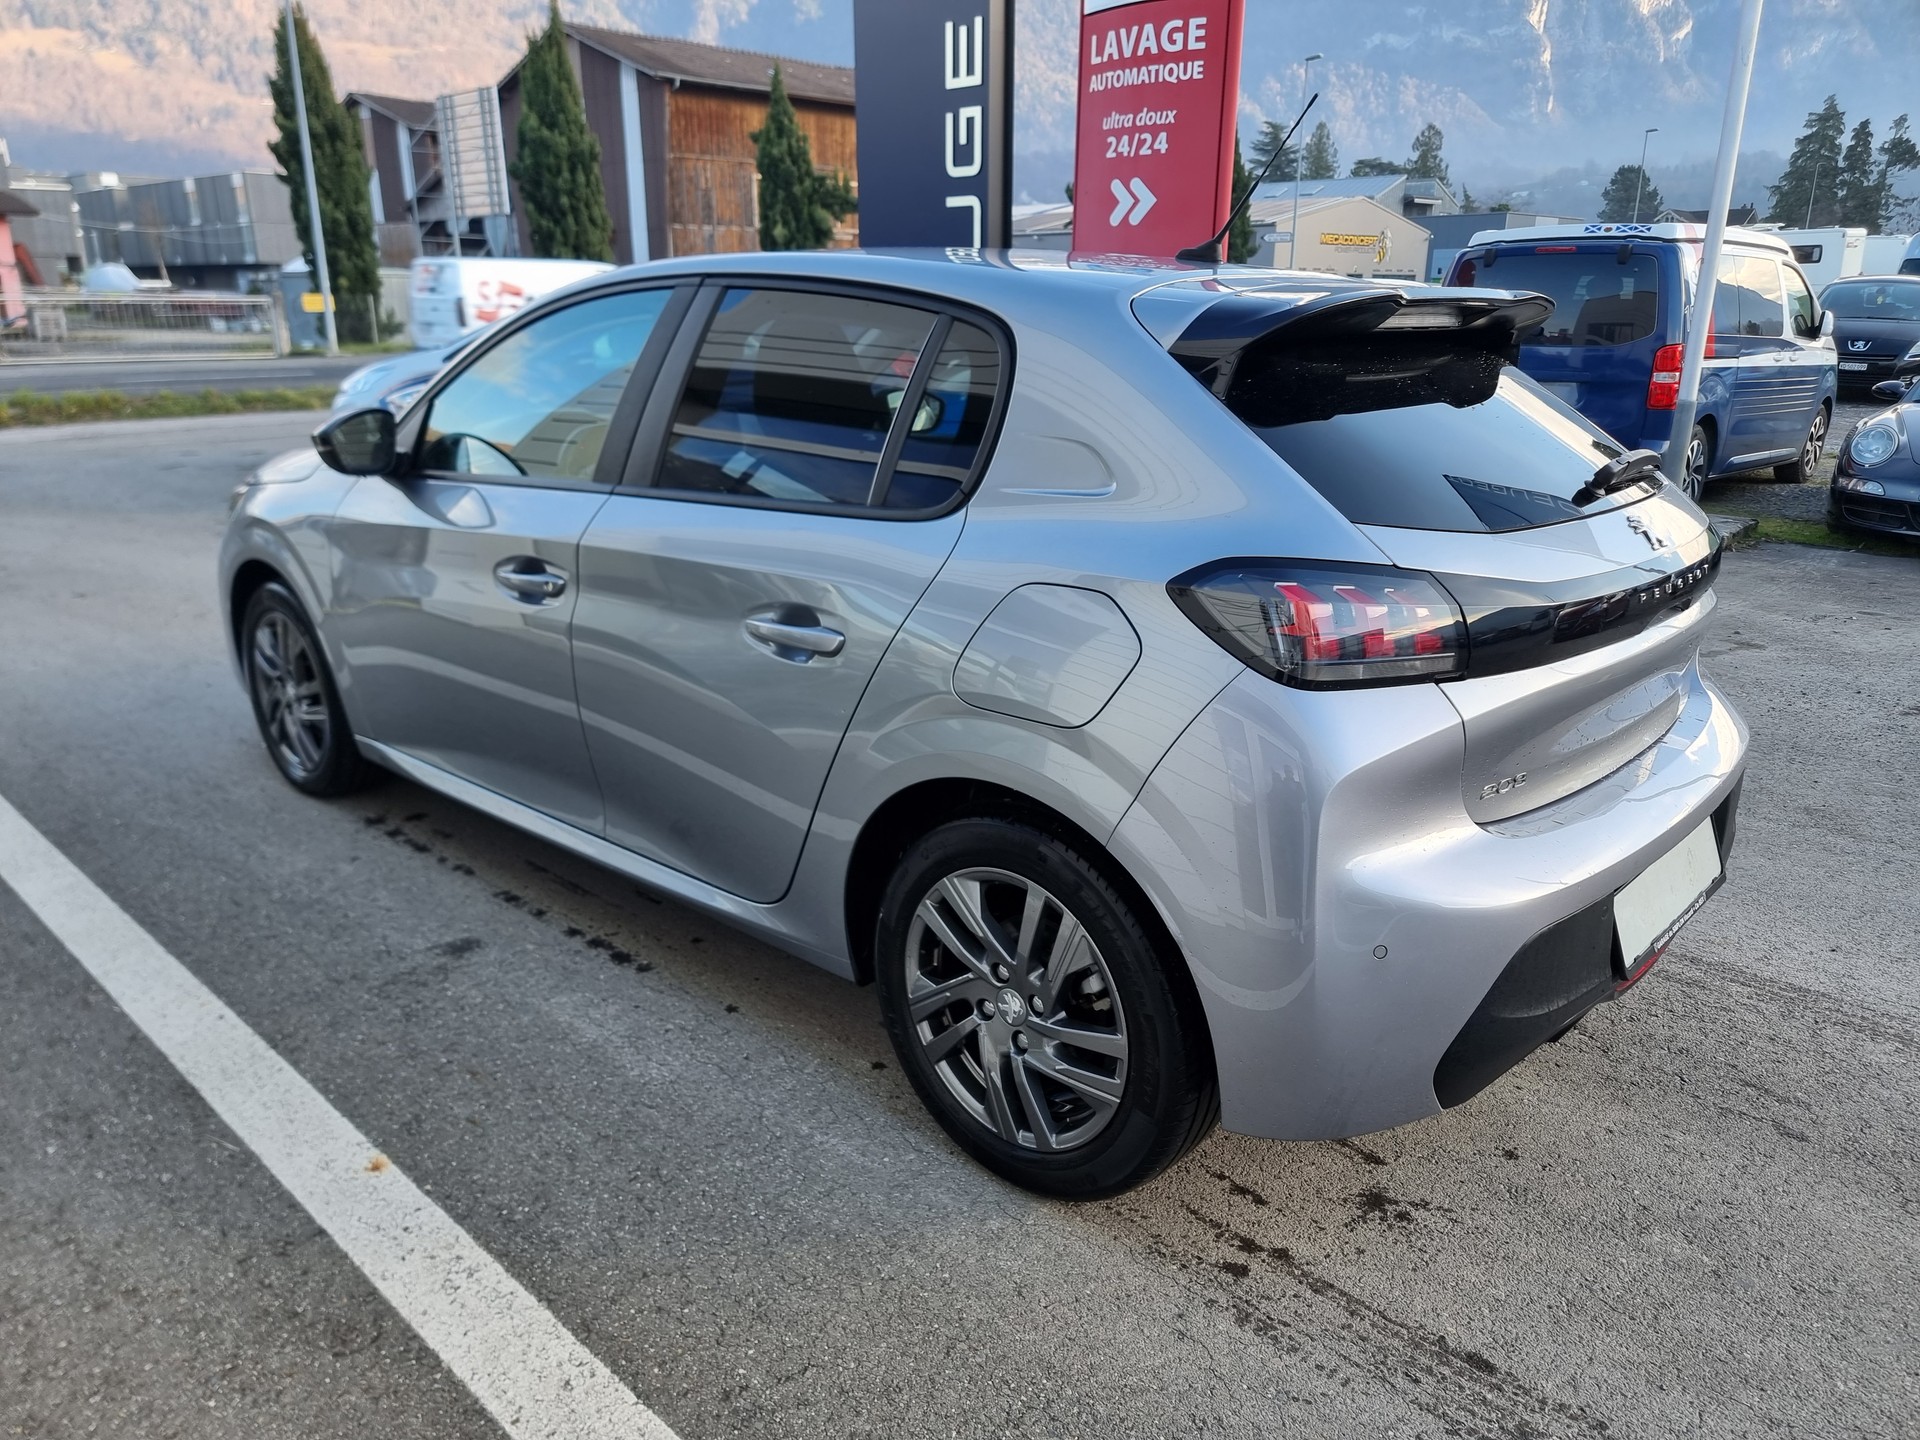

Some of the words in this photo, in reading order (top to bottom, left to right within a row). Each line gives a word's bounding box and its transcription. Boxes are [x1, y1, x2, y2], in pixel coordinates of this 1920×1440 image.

[1089, 16, 1207, 66] LAVAGE
[1088, 60, 1205, 94] AUTOMATIQUE
[1102, 109, 1134, 131] ultra
[1135, 106, 1178, 128] doux
[1105, 131, 1169, 159] 24/24
[1639, 564, 1710, 604] PEUGEOT
[1479, 771, 1528, 801] 208
